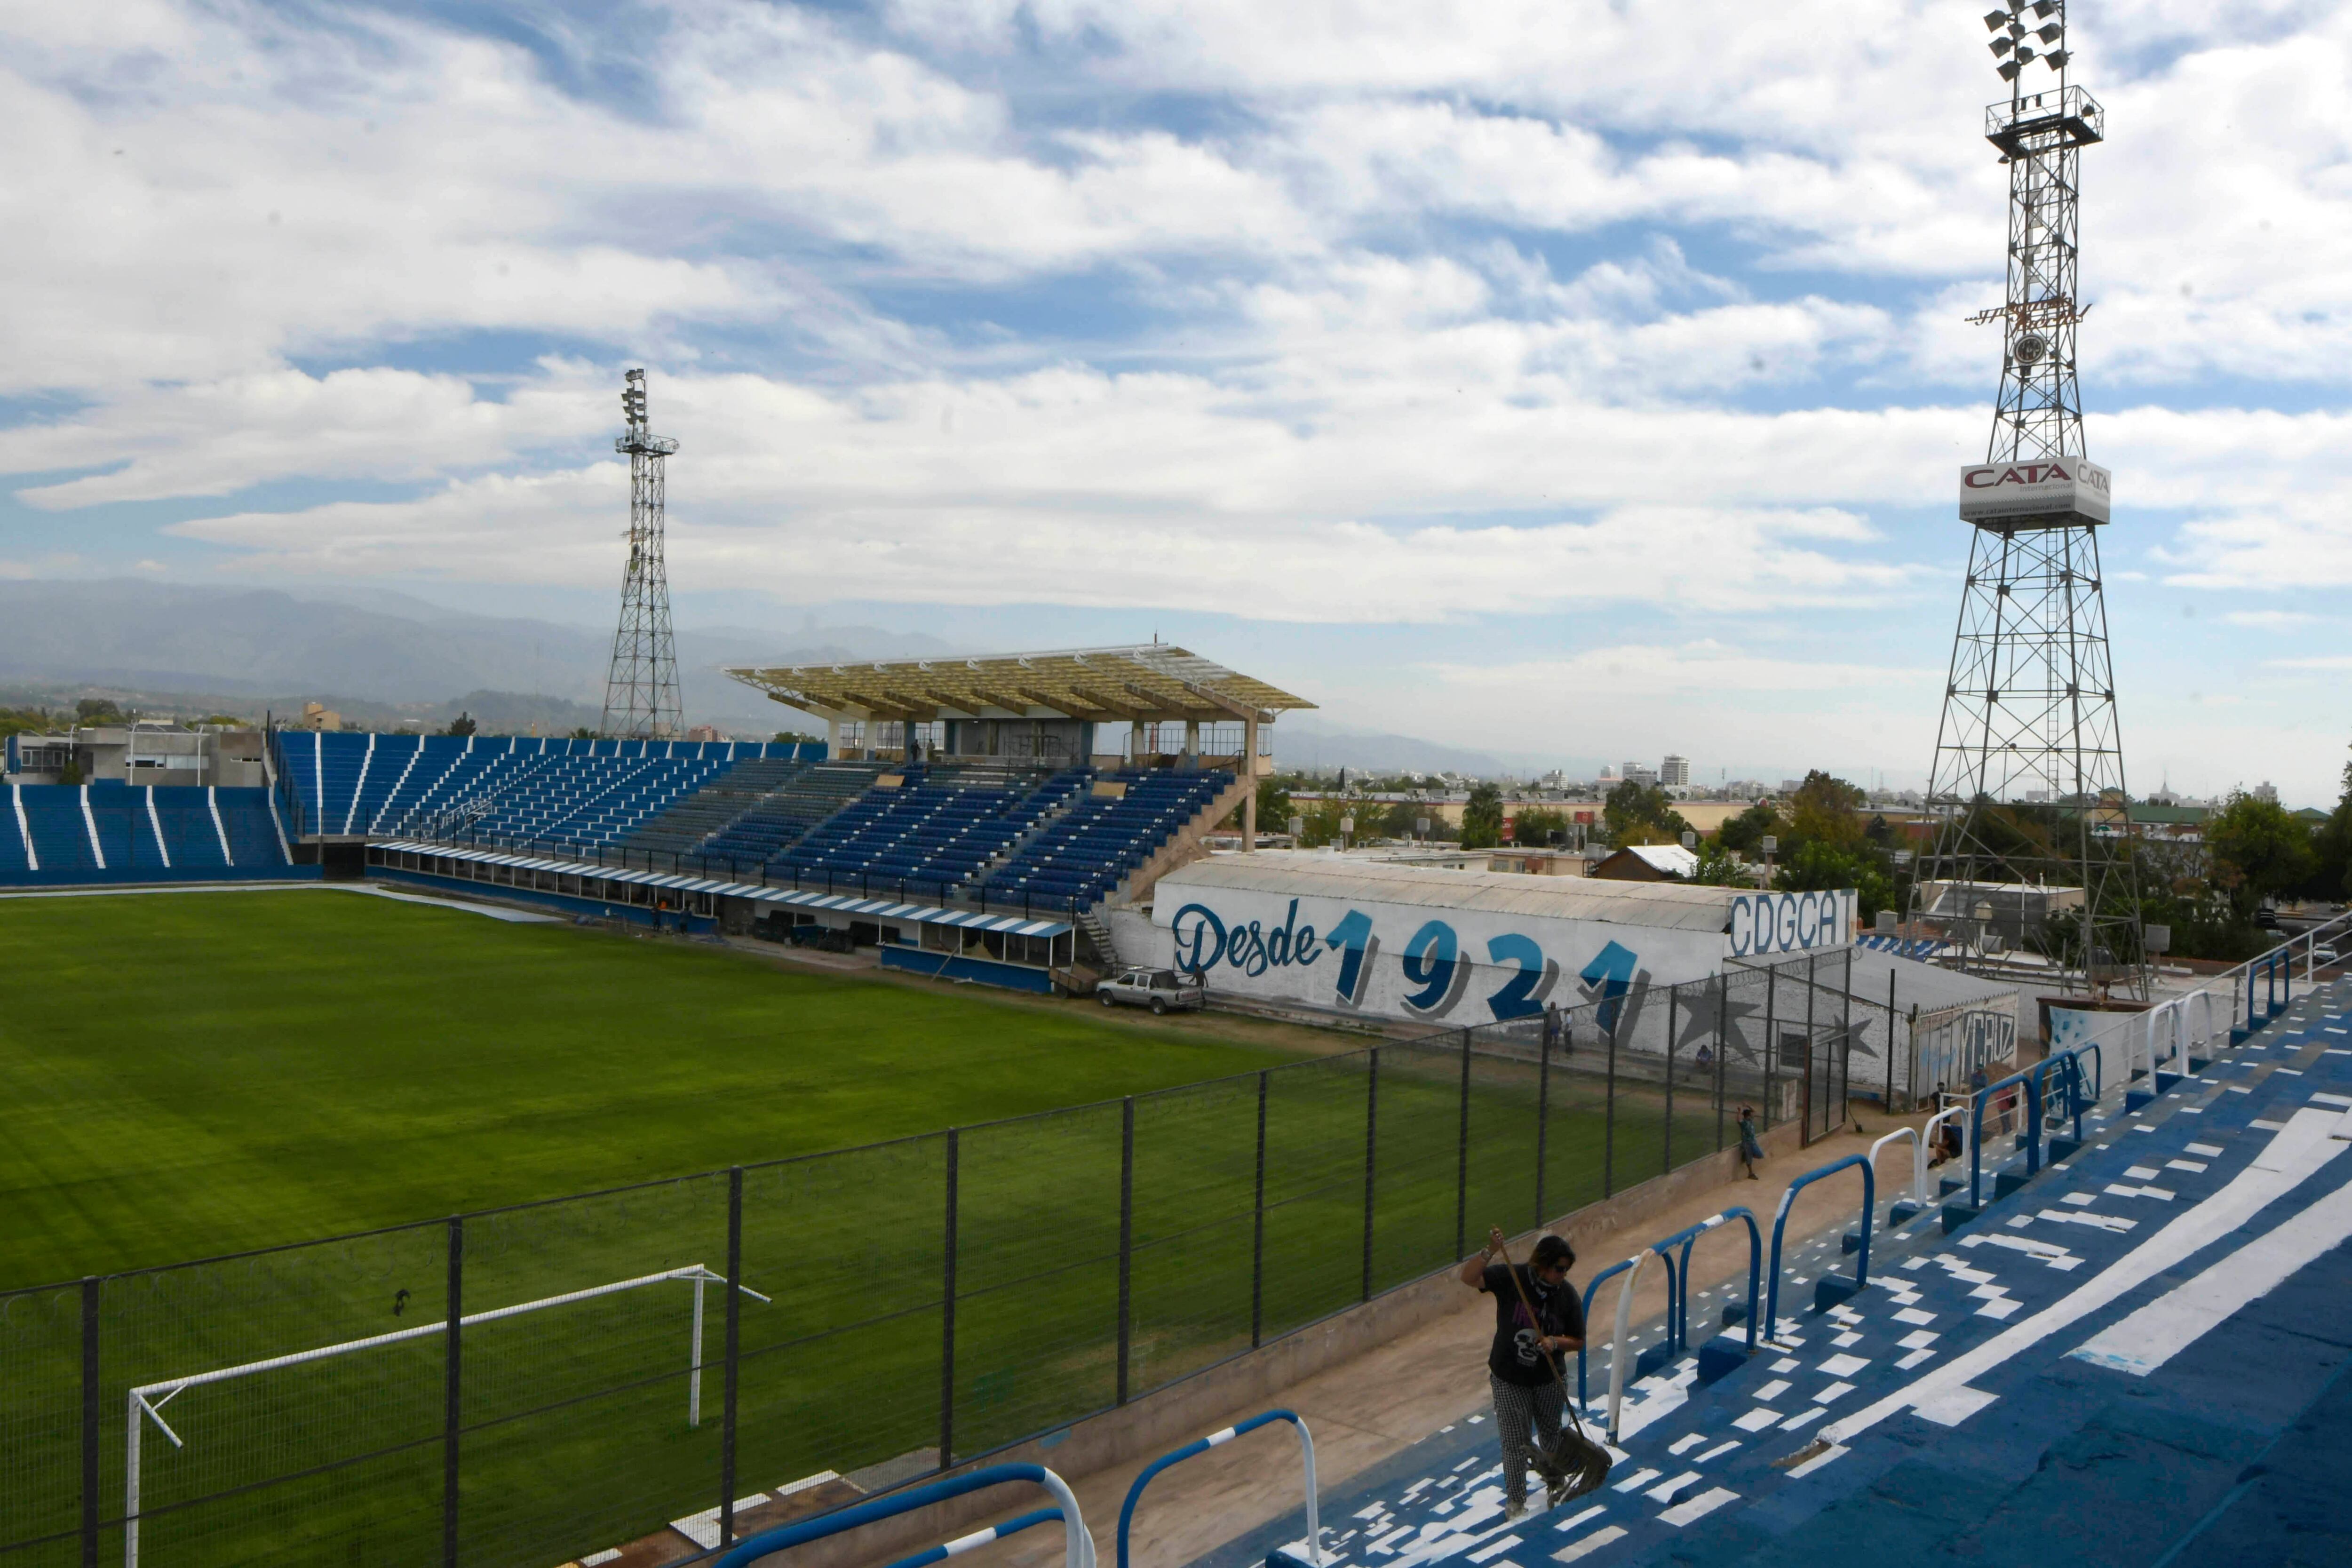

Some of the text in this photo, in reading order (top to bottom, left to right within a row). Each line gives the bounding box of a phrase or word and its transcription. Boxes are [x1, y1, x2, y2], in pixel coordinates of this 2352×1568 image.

[1964, 463, 2072, 488] CATA
[2077, 463, 2109, 494] CATA
[1963, 503, 2072, 517] www.catainternacional.com
[1731, 888, 1856, 957] CDGCAT
[1172, 897, 1645, 1037] Desde 1921
